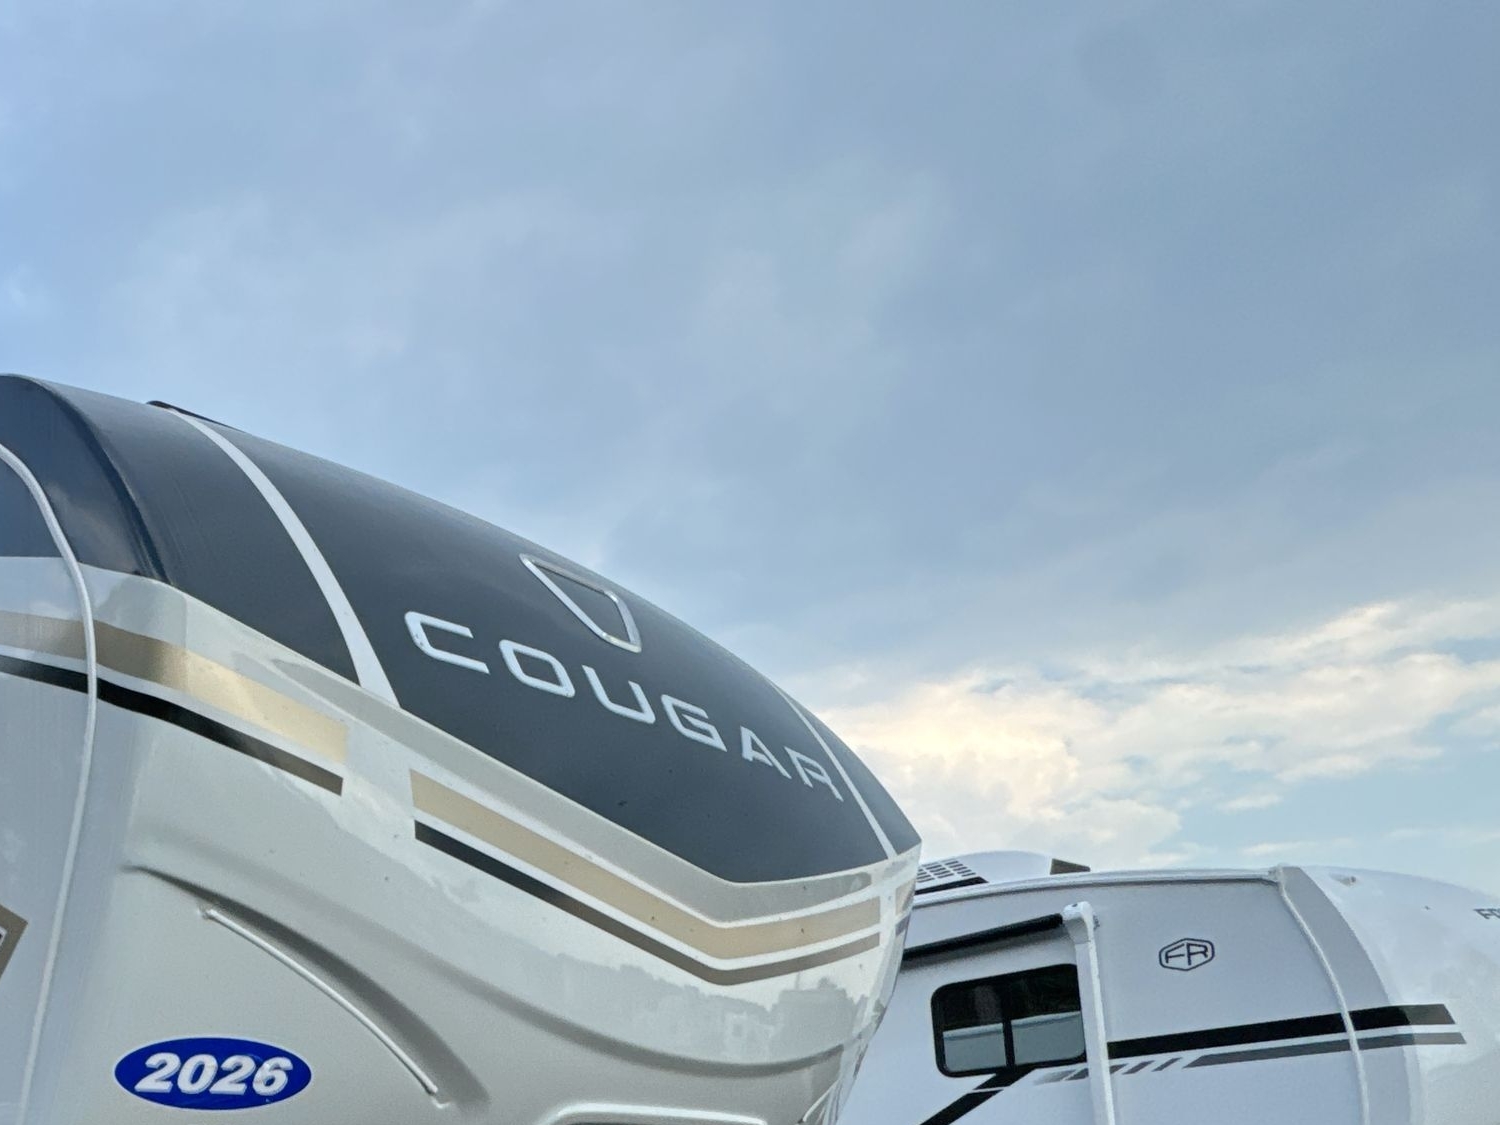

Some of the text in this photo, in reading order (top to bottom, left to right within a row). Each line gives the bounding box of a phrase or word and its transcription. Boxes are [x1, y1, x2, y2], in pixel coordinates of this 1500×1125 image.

[404, 610, 845, 802] COUGAR
[1165, 942, 1208, 966] FR
[134, 1052, 294, 1096] 2026
